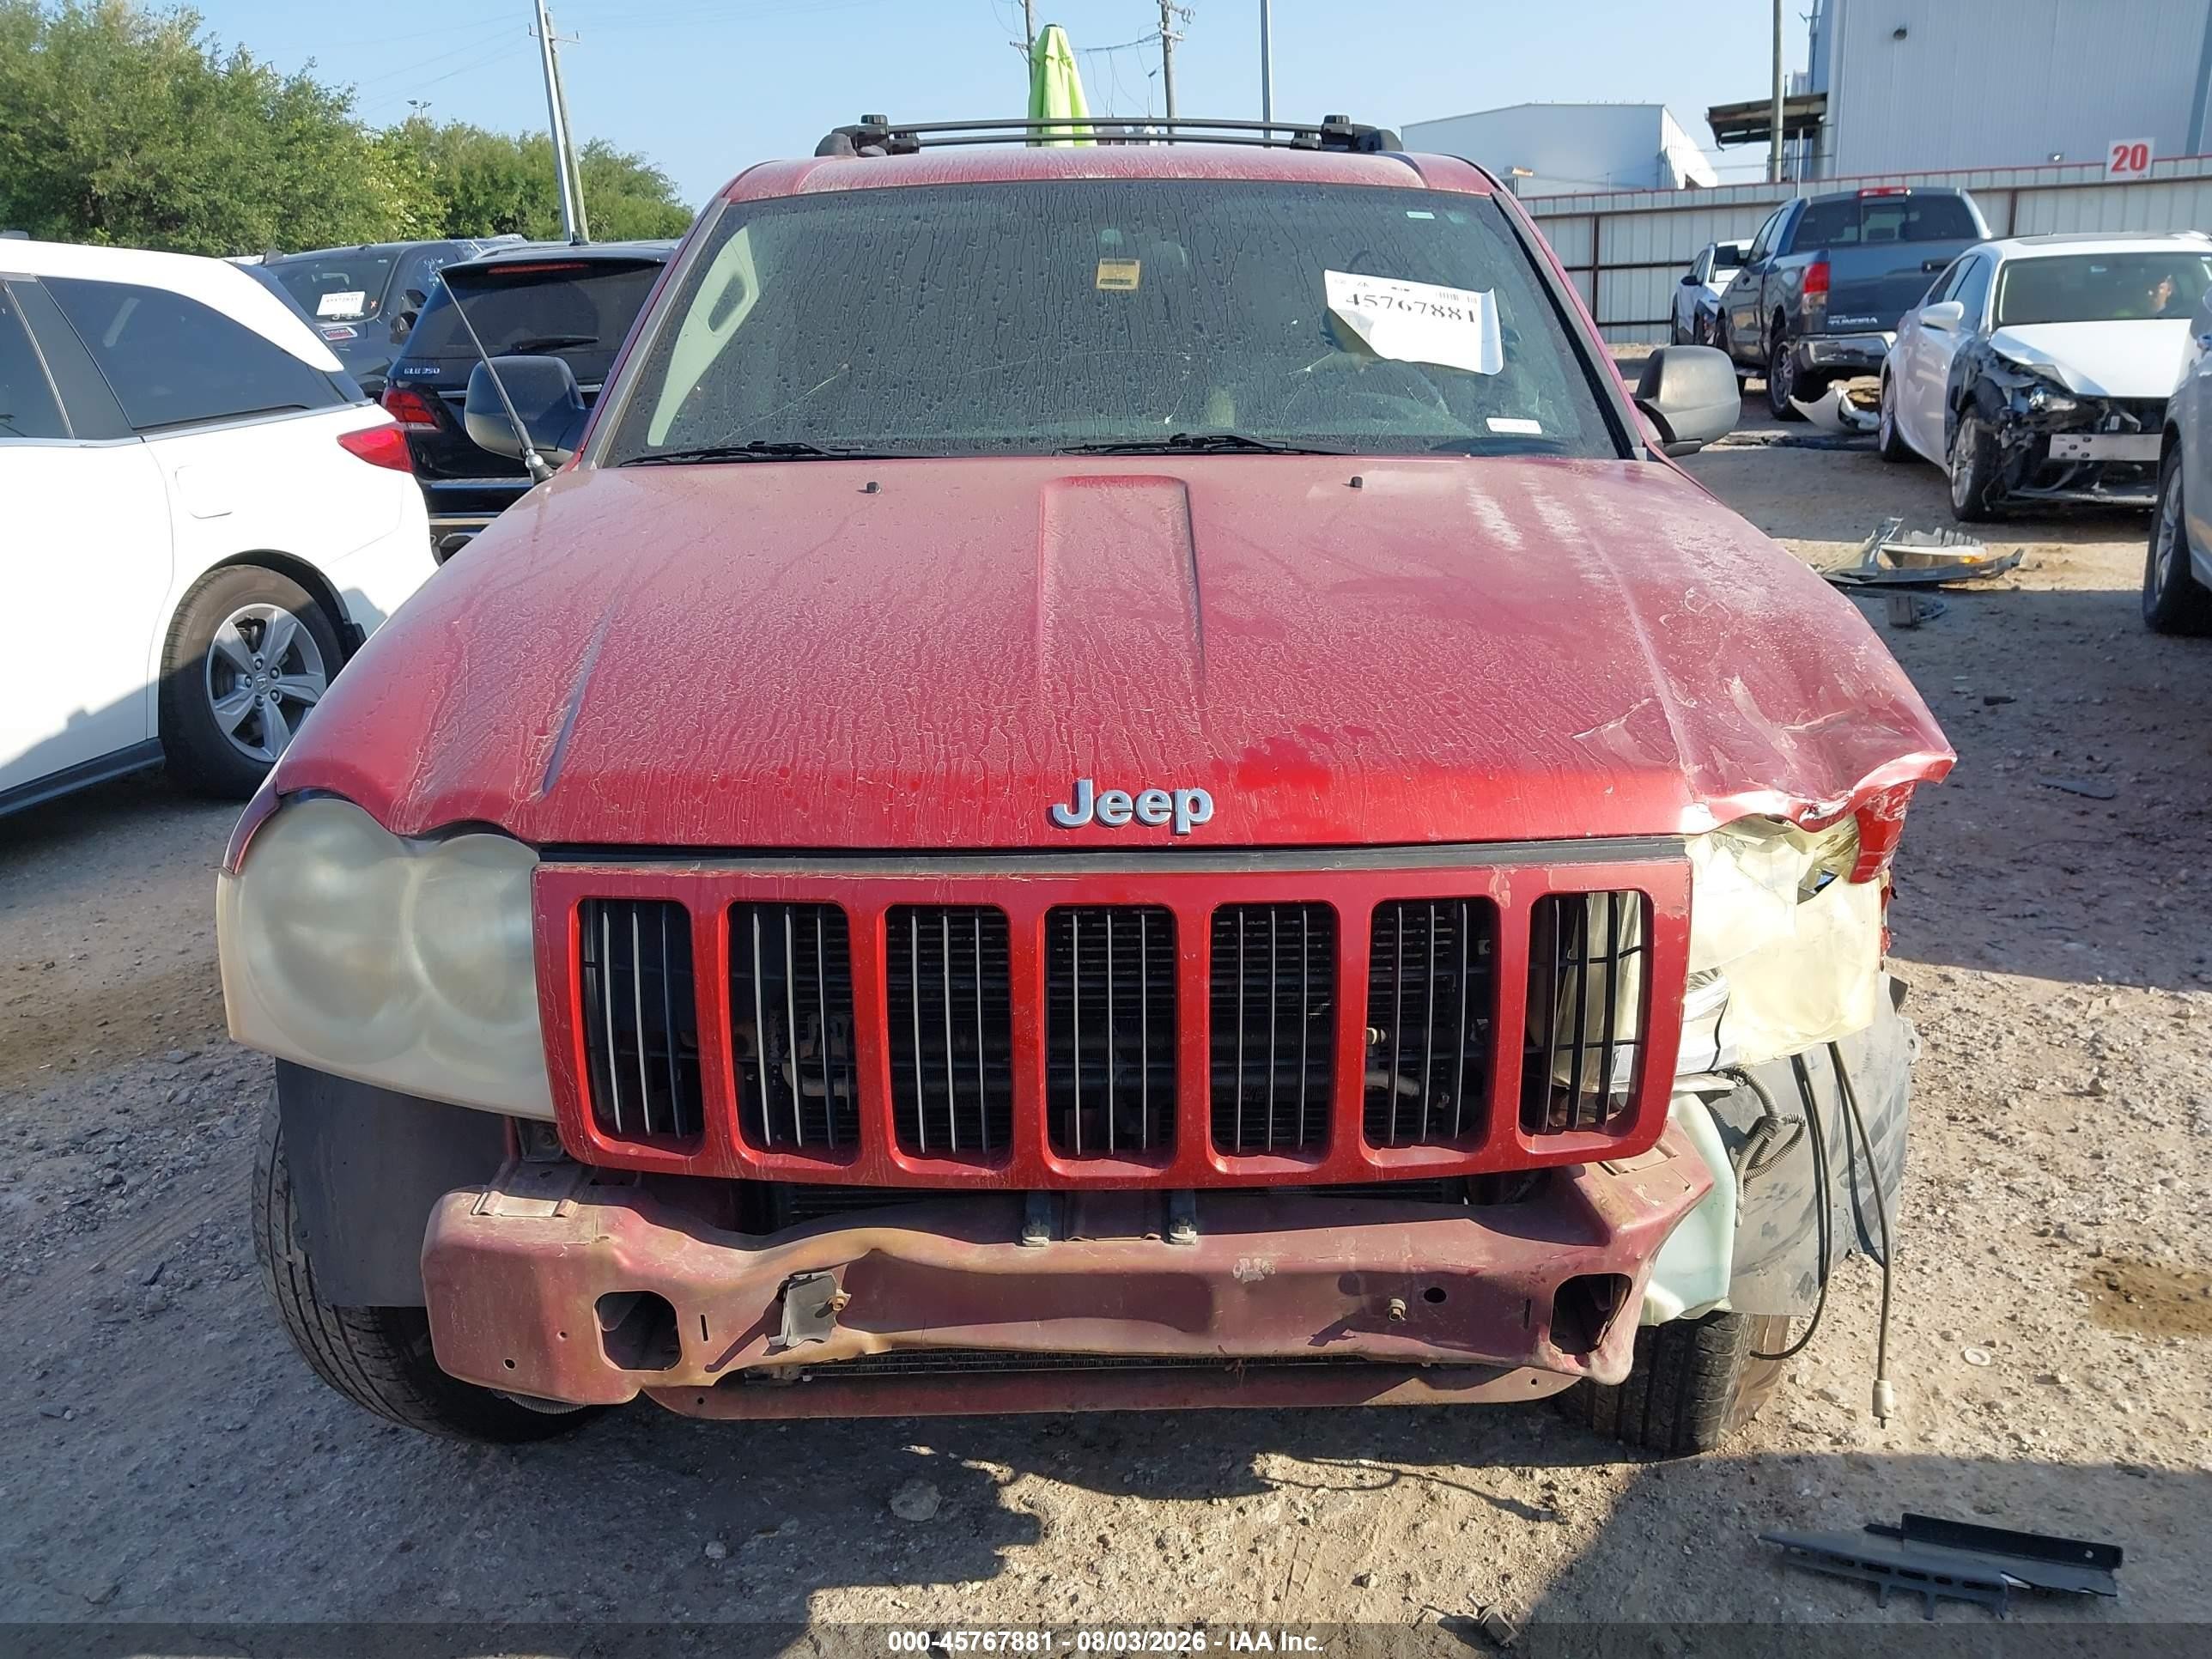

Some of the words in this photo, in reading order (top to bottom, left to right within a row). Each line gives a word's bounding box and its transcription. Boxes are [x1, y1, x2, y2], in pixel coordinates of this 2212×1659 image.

[2111, 143, 2148, 173] 20
[1346, 293, 1475, 323] 45767881
[1052, 778, 1213, 835] Jeep
